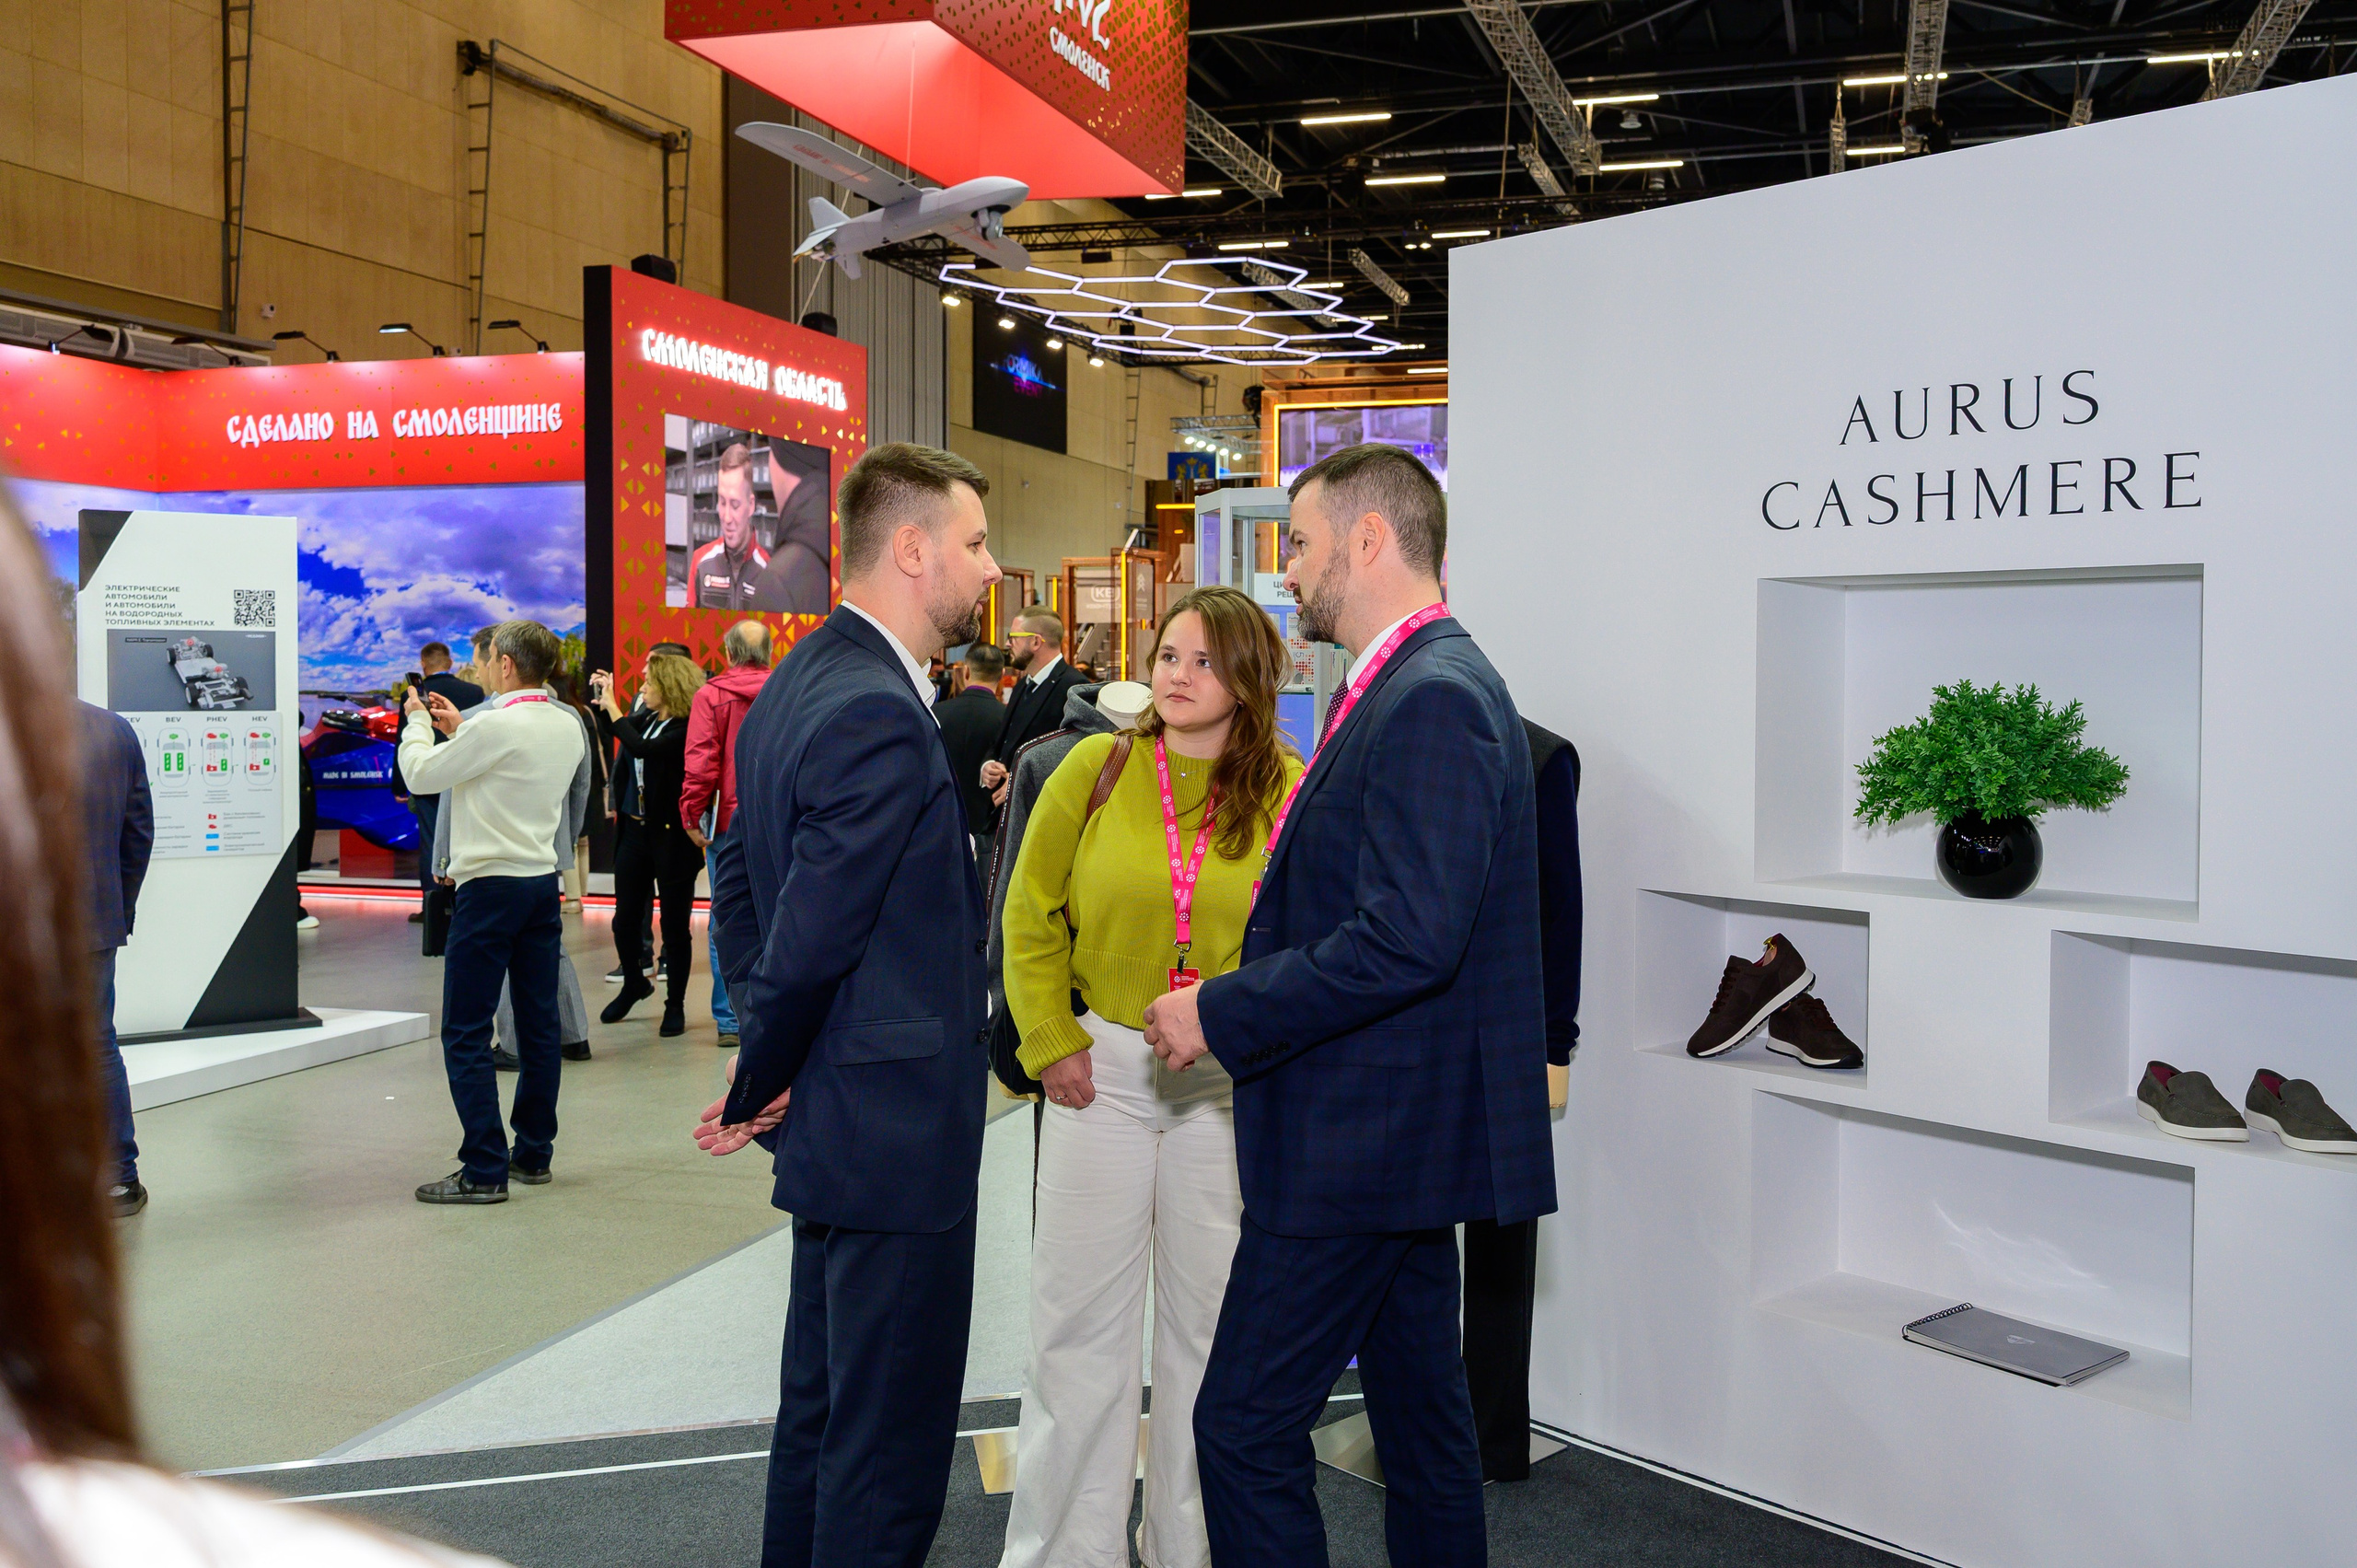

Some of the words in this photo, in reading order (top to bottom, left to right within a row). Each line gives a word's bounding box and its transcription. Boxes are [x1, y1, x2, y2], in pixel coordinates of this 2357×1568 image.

[1050, 26, 1110, 91] СМОЛЕНСК
[642, 328, 771, 391] СМОЛЕНСКАЯ
[774, 366, 849, 412] ОБЛАСТЬ
[1838, 369, 2099, 446] AURUS
[226, 412, 334, 449] СДЕЛАНО
[347, 410, 379, 440] НА
[392, 402, 563, 440] СМОЛЕНЩИНЕ
[1760, 450, 2202, 531] CASHMERE
